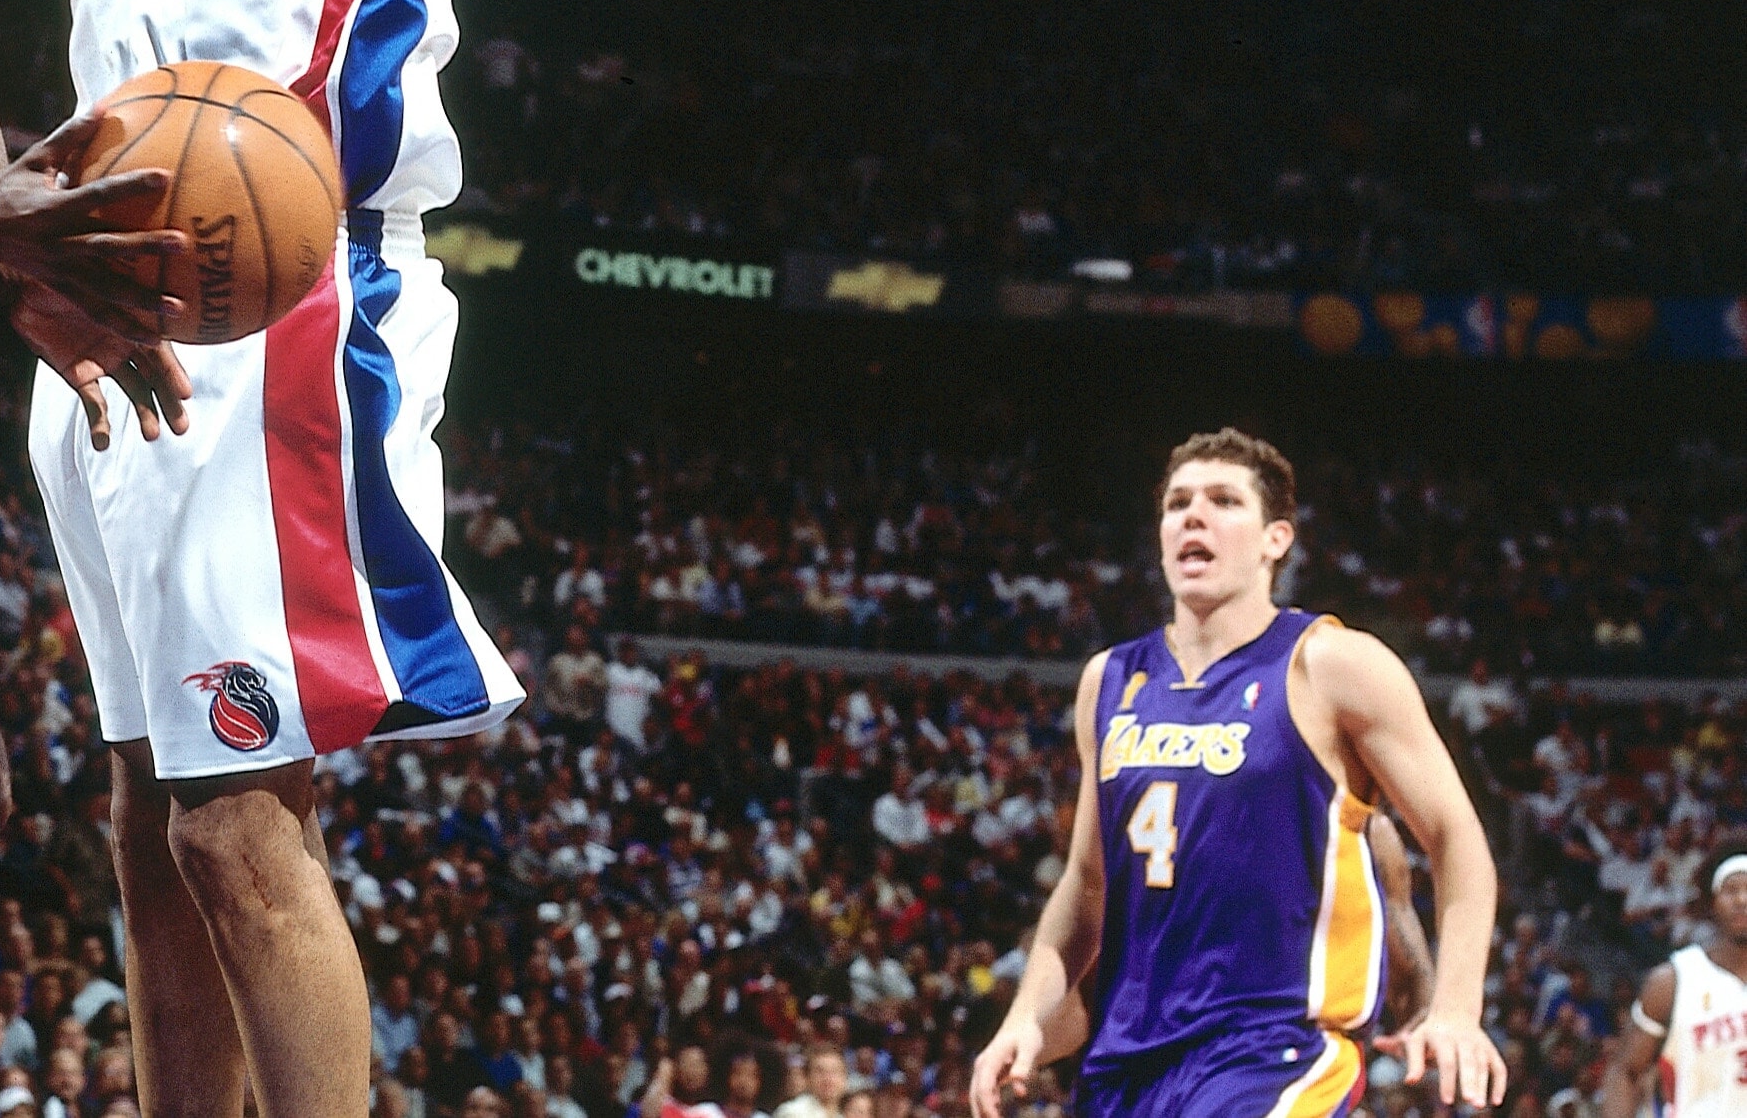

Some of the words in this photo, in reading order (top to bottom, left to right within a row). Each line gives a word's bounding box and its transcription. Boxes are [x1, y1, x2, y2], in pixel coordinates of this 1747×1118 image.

[575, 248, 774, 299] CHEVROLET
[1100, 713, 1251, 782] LAKERS
[1127, 781, 1179, 889] 4
